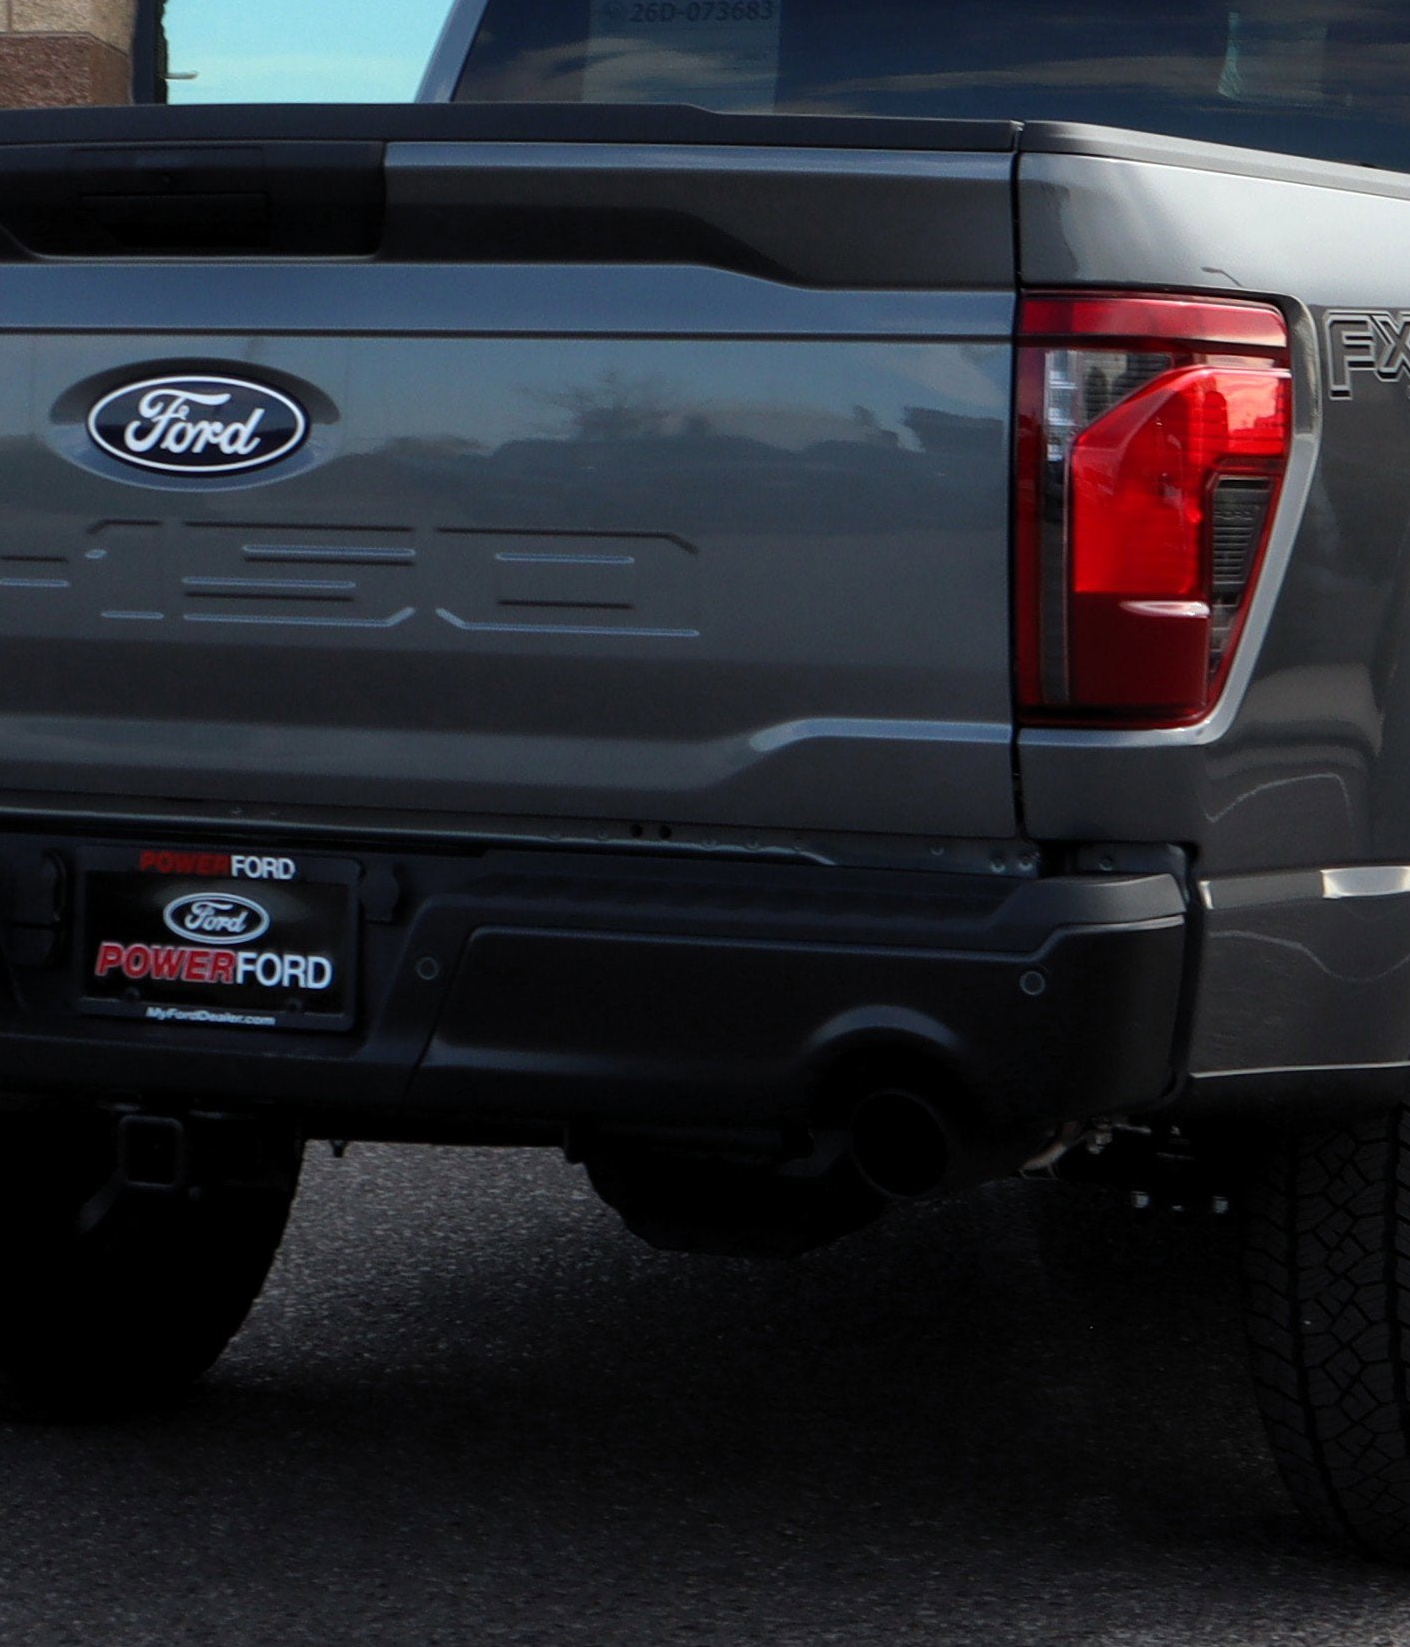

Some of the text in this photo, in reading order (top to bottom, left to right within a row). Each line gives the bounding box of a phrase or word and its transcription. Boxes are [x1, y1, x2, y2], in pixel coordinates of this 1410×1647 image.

[123, 388, 265, 455] Ford
[184, 902, 248, 934] Ford
[146, 1006, 277, 1027] MyFordDealer.com
